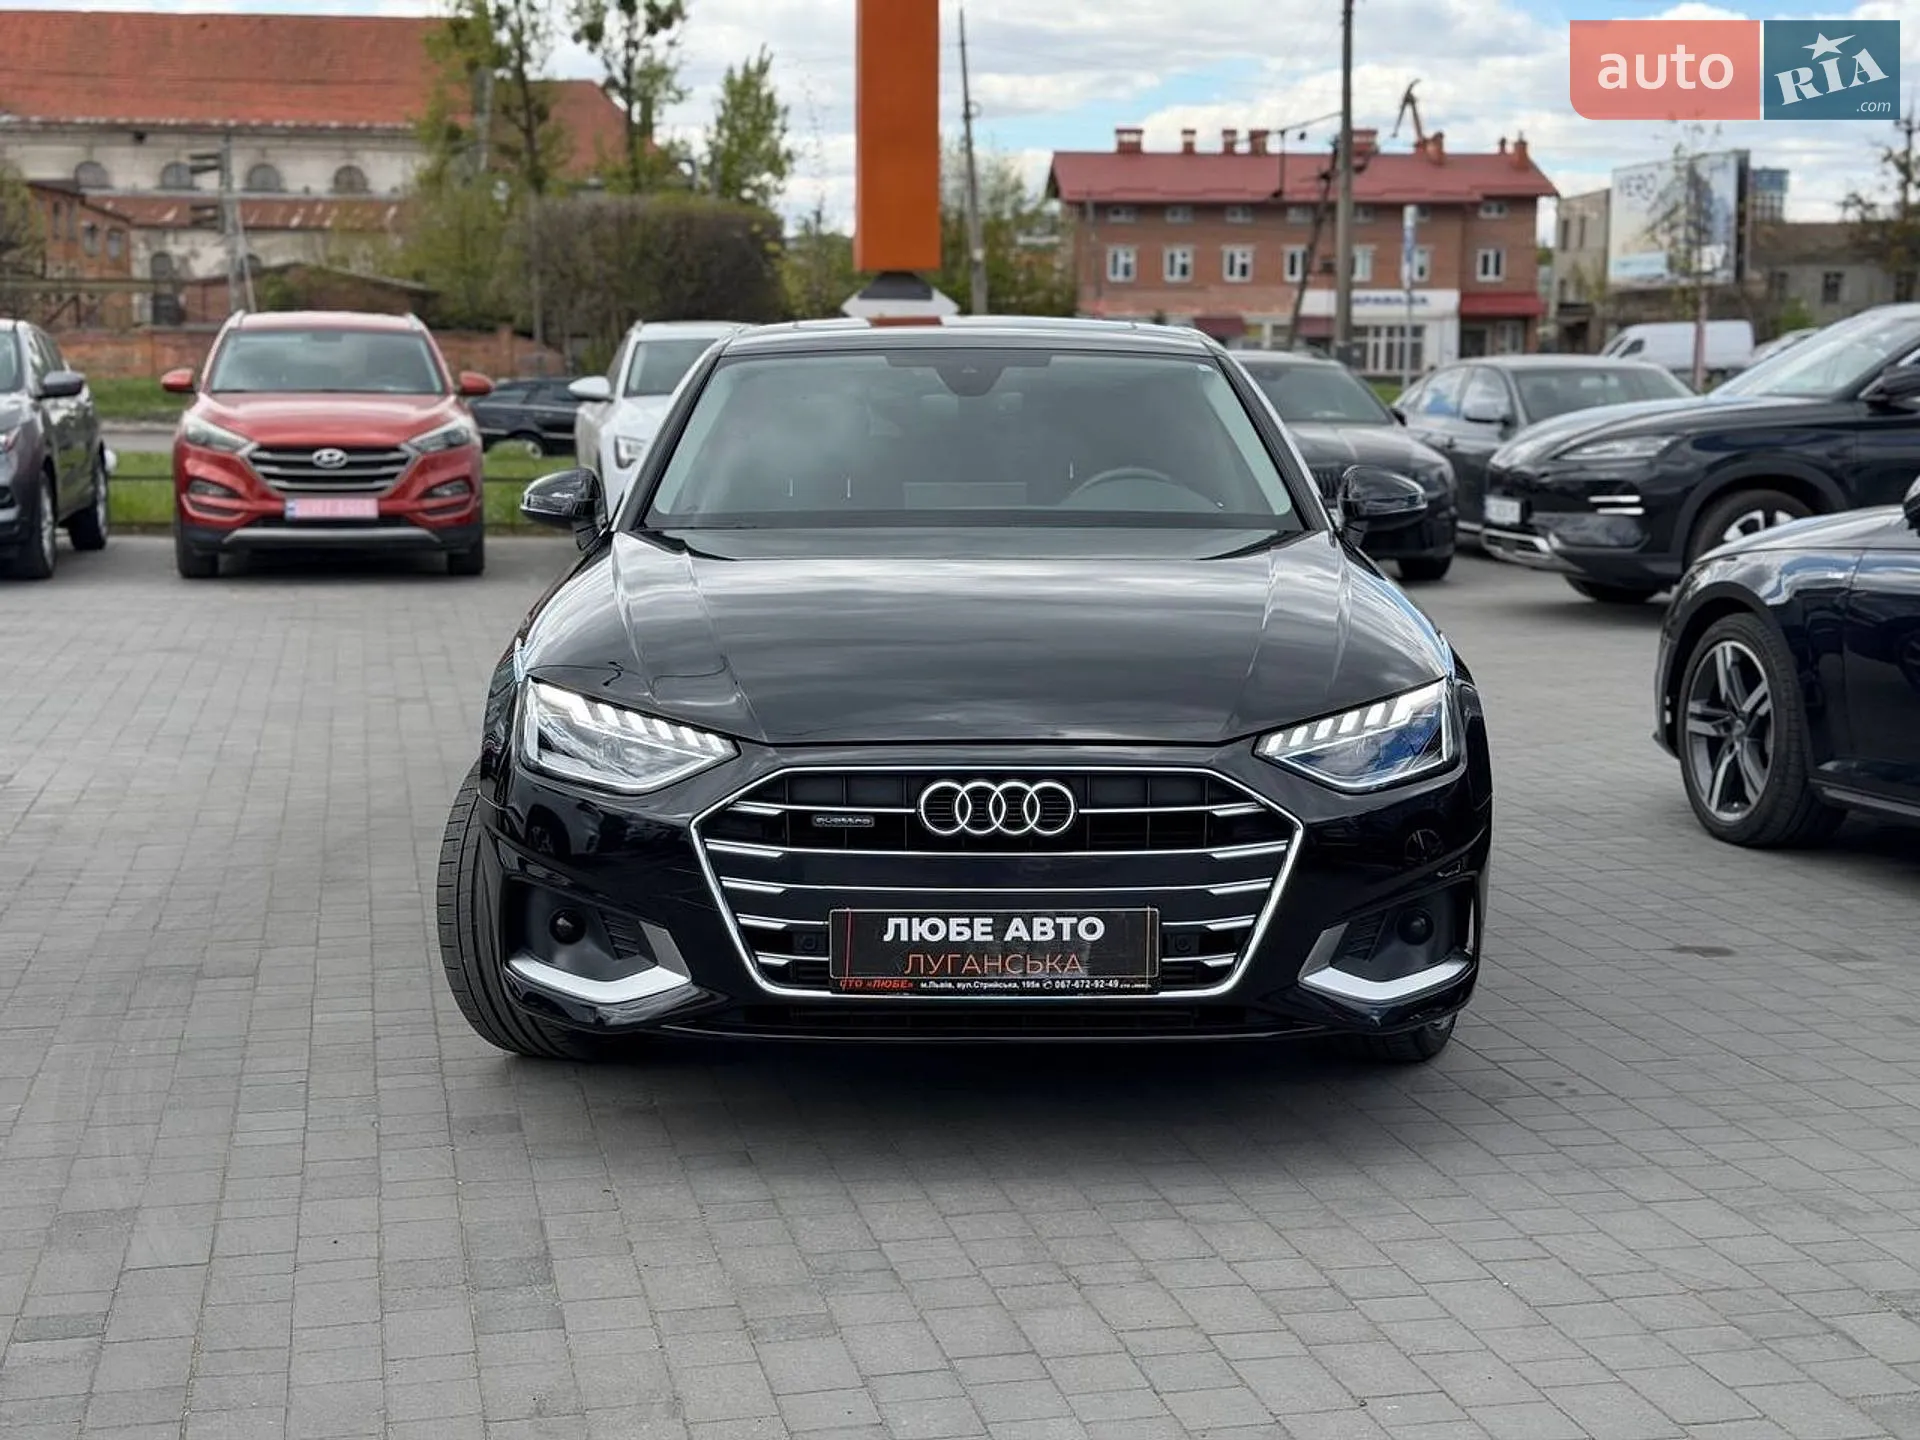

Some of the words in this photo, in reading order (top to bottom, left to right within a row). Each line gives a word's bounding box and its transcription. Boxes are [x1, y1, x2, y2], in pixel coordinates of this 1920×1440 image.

[884, 917, 993, 942] ЛЮБЕ
[1004, 917, 1105, 942] АВТО
[904, 953, 1083, 976] ЛУГАНСЬКА
